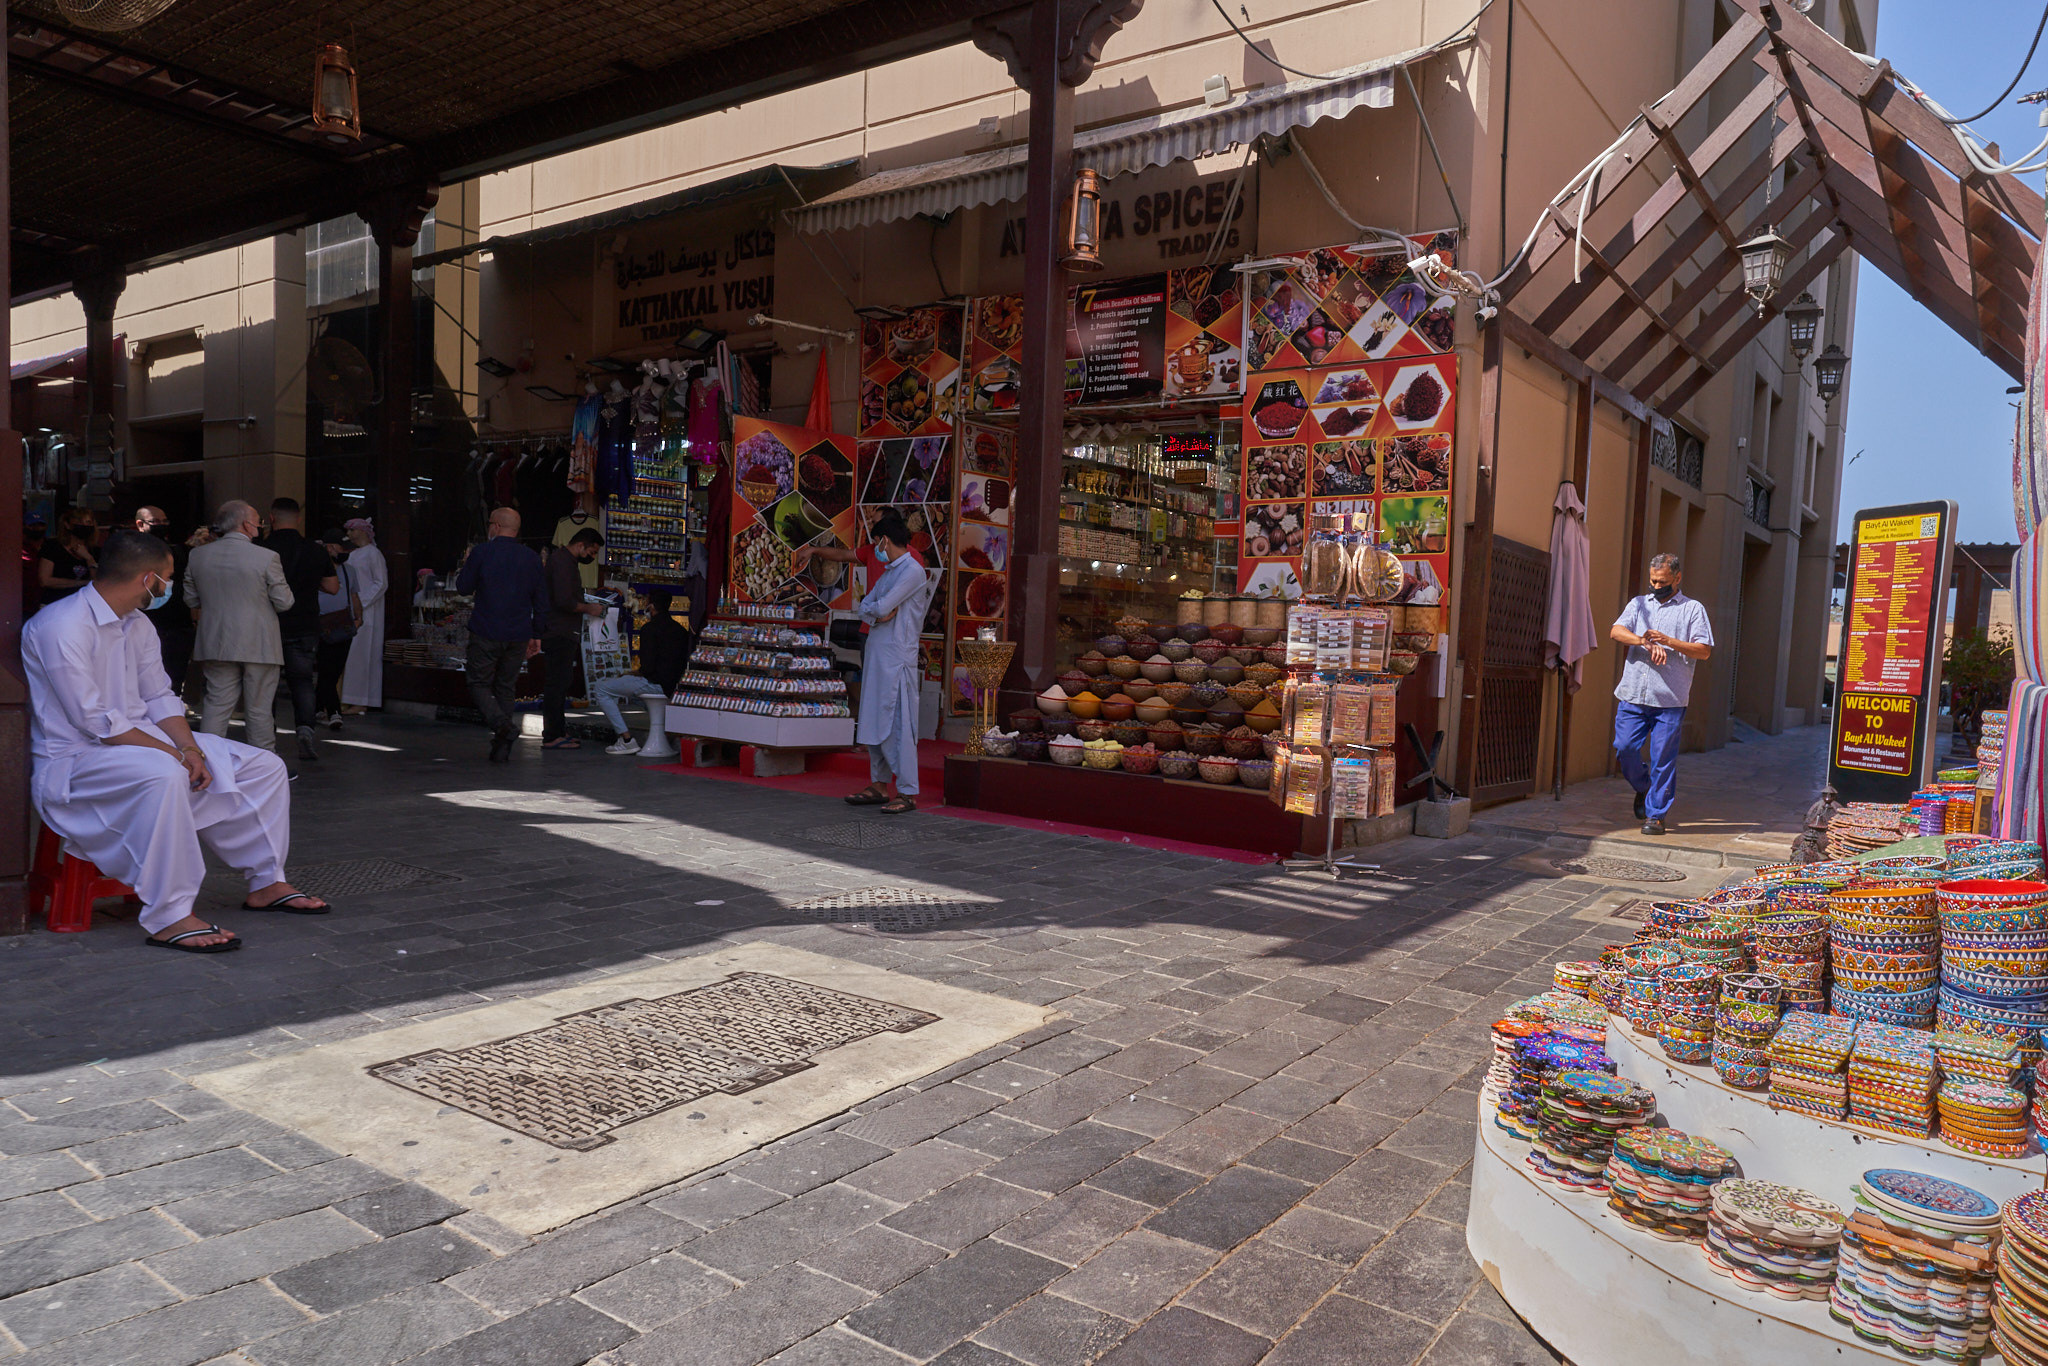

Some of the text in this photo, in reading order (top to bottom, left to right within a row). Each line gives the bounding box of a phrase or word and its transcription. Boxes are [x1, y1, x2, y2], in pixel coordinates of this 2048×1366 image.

[1133, 178, 1244, 236] SPICES
[669, 246, 717, 278] يوسف
[616, 249, 665, 290] للتجارة
[620, 284, 719, 328] KATTAKKAL
[1081, 289, 1097, 312] 7
[1093, 301, 1110, 310] Health
[1111, 298, 1132, 308] Benefits
[1133, 296, 1141, 306] Of
[1096, 310, 1117, 319] Protects
[1117, 308, 1135, 318] against
[1136, 306, 1153, 314] cancer
[1096, 320, 1118, 330] Promotes
[1118, 318, 1139, 328] learning
[1095, 329, 1137, 341] memory retention
[1101, 342, 1120, 350] delayed
[1120, 340, 1139, 350] puberty
[1101, 352, 1122, 361] increase
[1122, 350, 1140, 359] vitality
[1100, 363, 1117, 372] patchy
[1117, 361, 1139, 370] baldness
[1094, 374, 1119, 382] Protection
[1119, 371, 1138, 381] against
[1138, 370, 1149, 378] cold
[1094, 385, 1106, 393] Food
[1106, 383, 1128, 392] Additives
[1865, 522, 1880, 530] Bayt
[1890, 518, 1915, 527] Wakeel
[1845, 696, 1911, 713] WELCOME
[1865, 714, 1883, 729] TO
[1844, 731, 1907, 748] Bayt Al Wakeel
[1843, 745, 1906, 758] Monument & Restaurant
